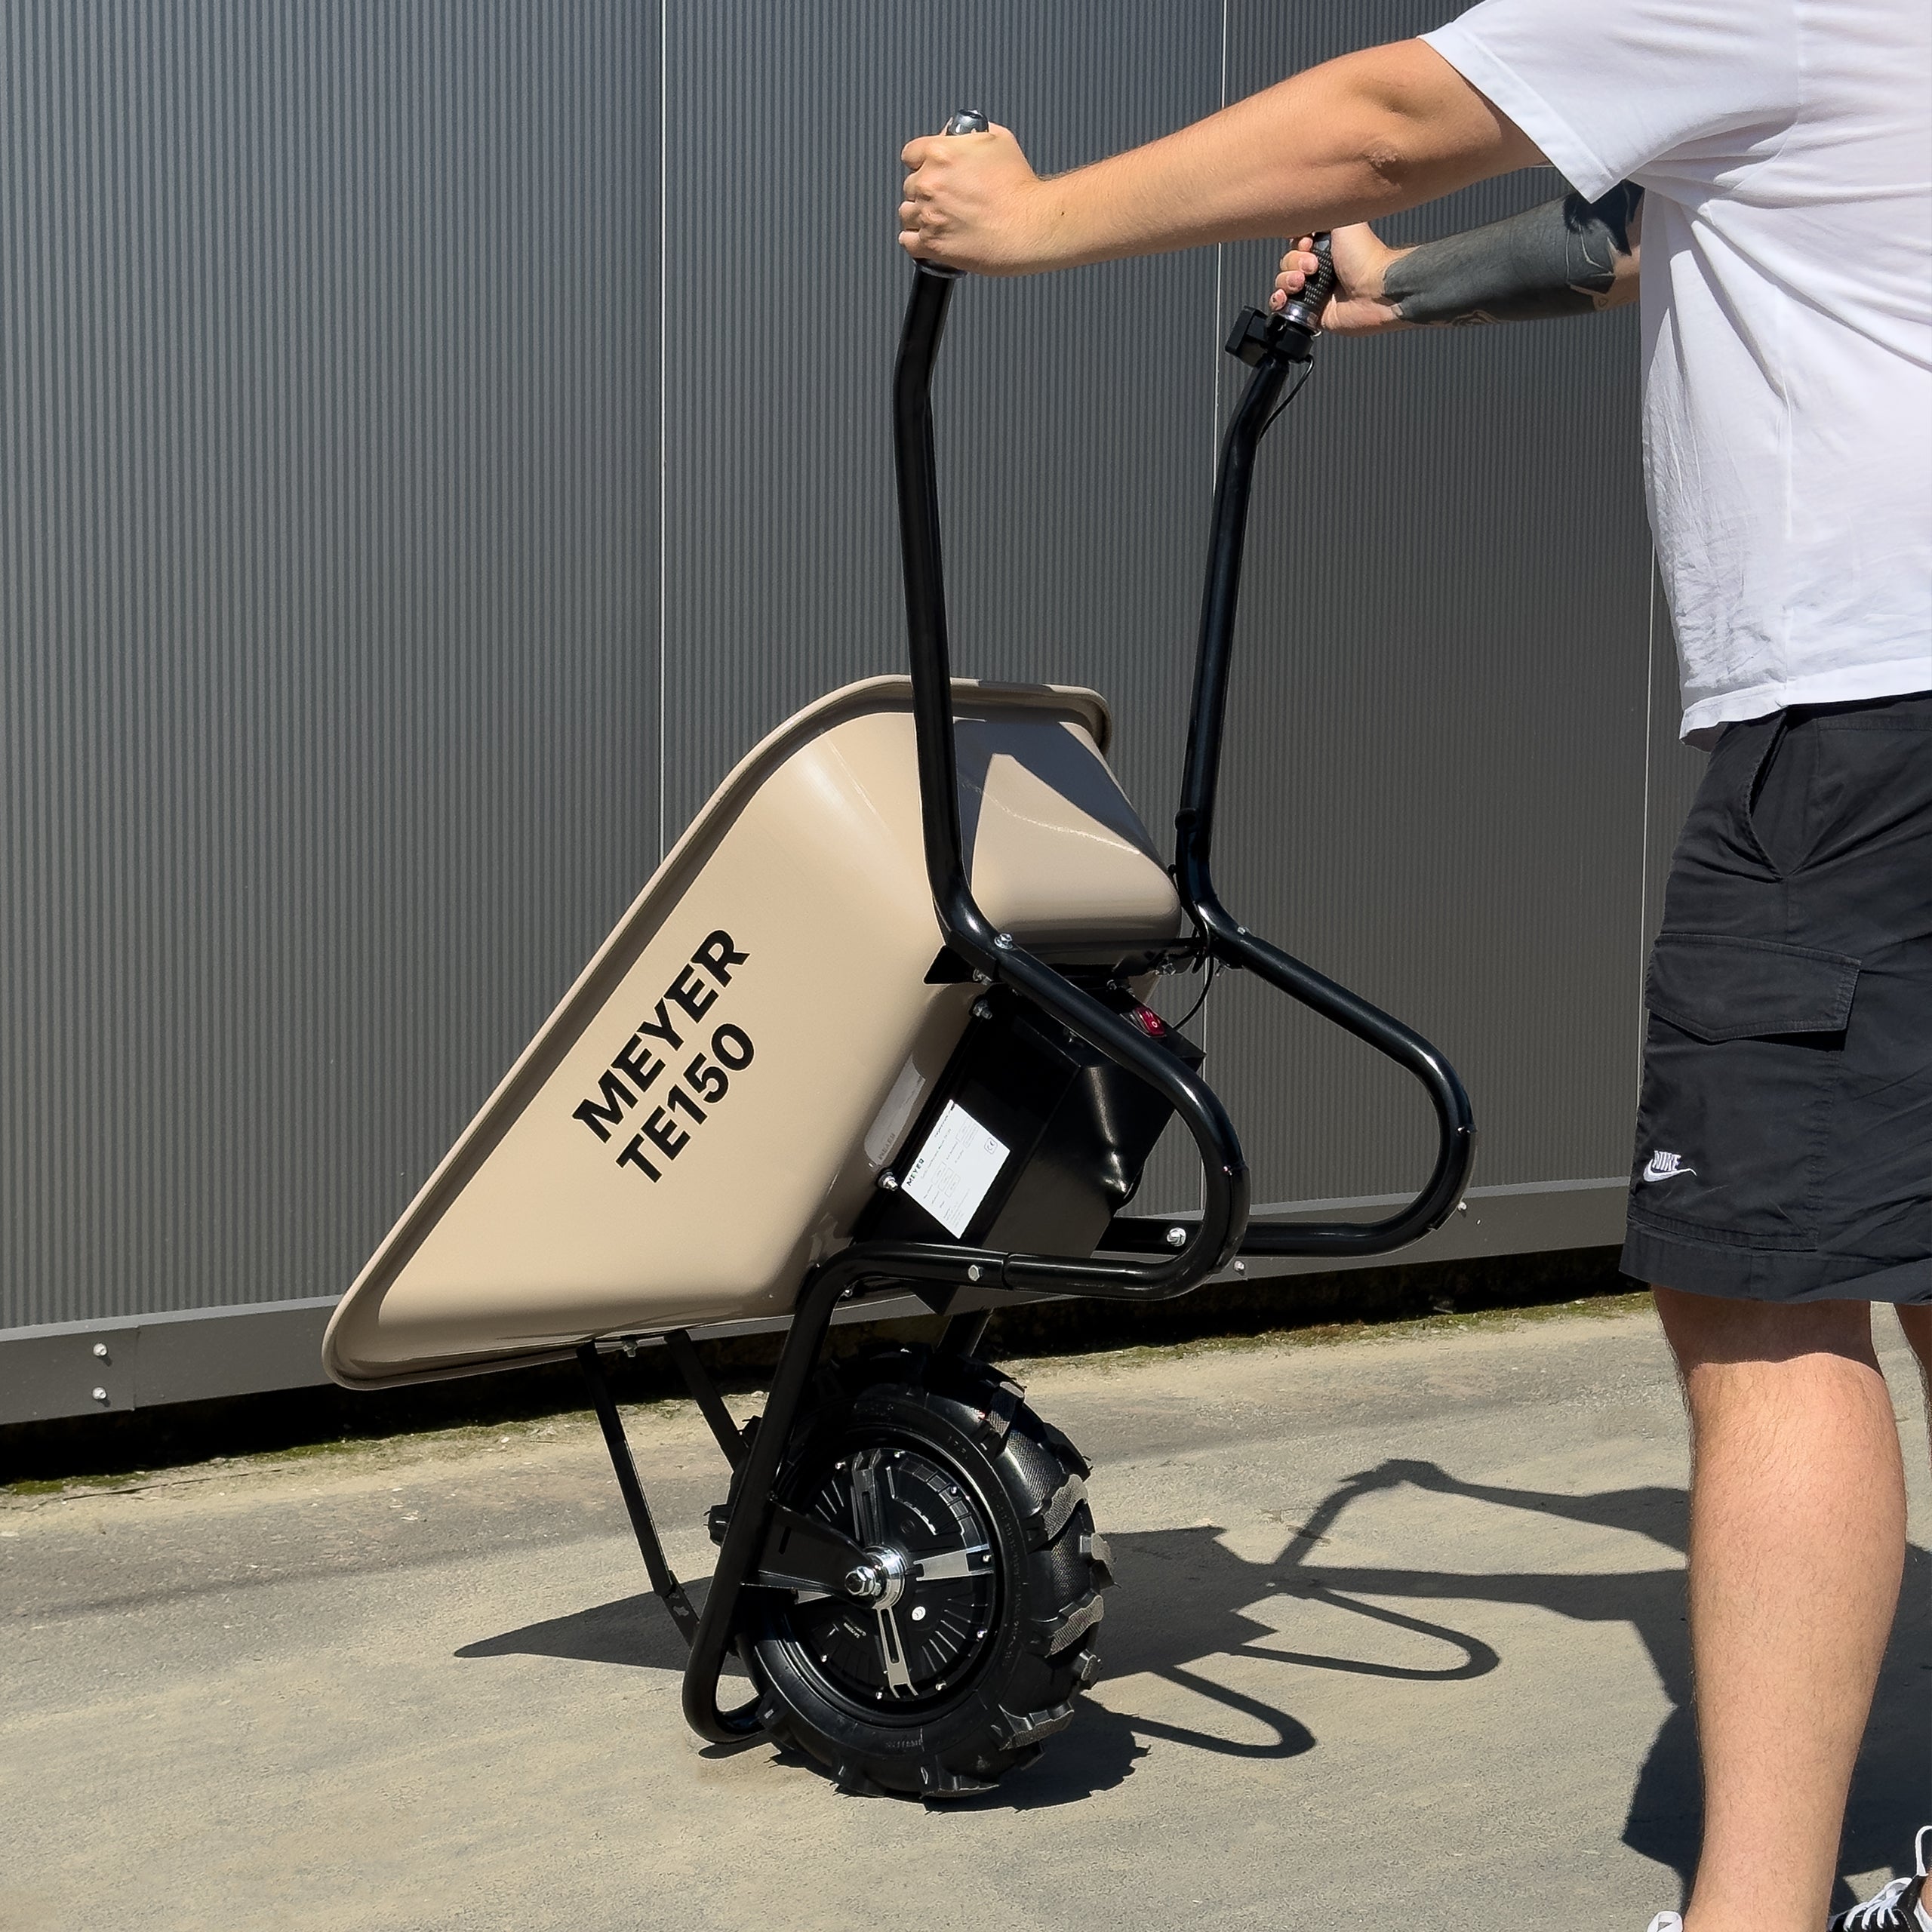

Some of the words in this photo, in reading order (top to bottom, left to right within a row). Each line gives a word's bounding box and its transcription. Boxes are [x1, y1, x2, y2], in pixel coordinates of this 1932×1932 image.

[572, 930, 750, 1143] MEYER
[615, 1023, 755, 1183] TE150
[906, 1158, 924, 1186] MEYER
[1652, 1150, 1681, 1171] NIKE
